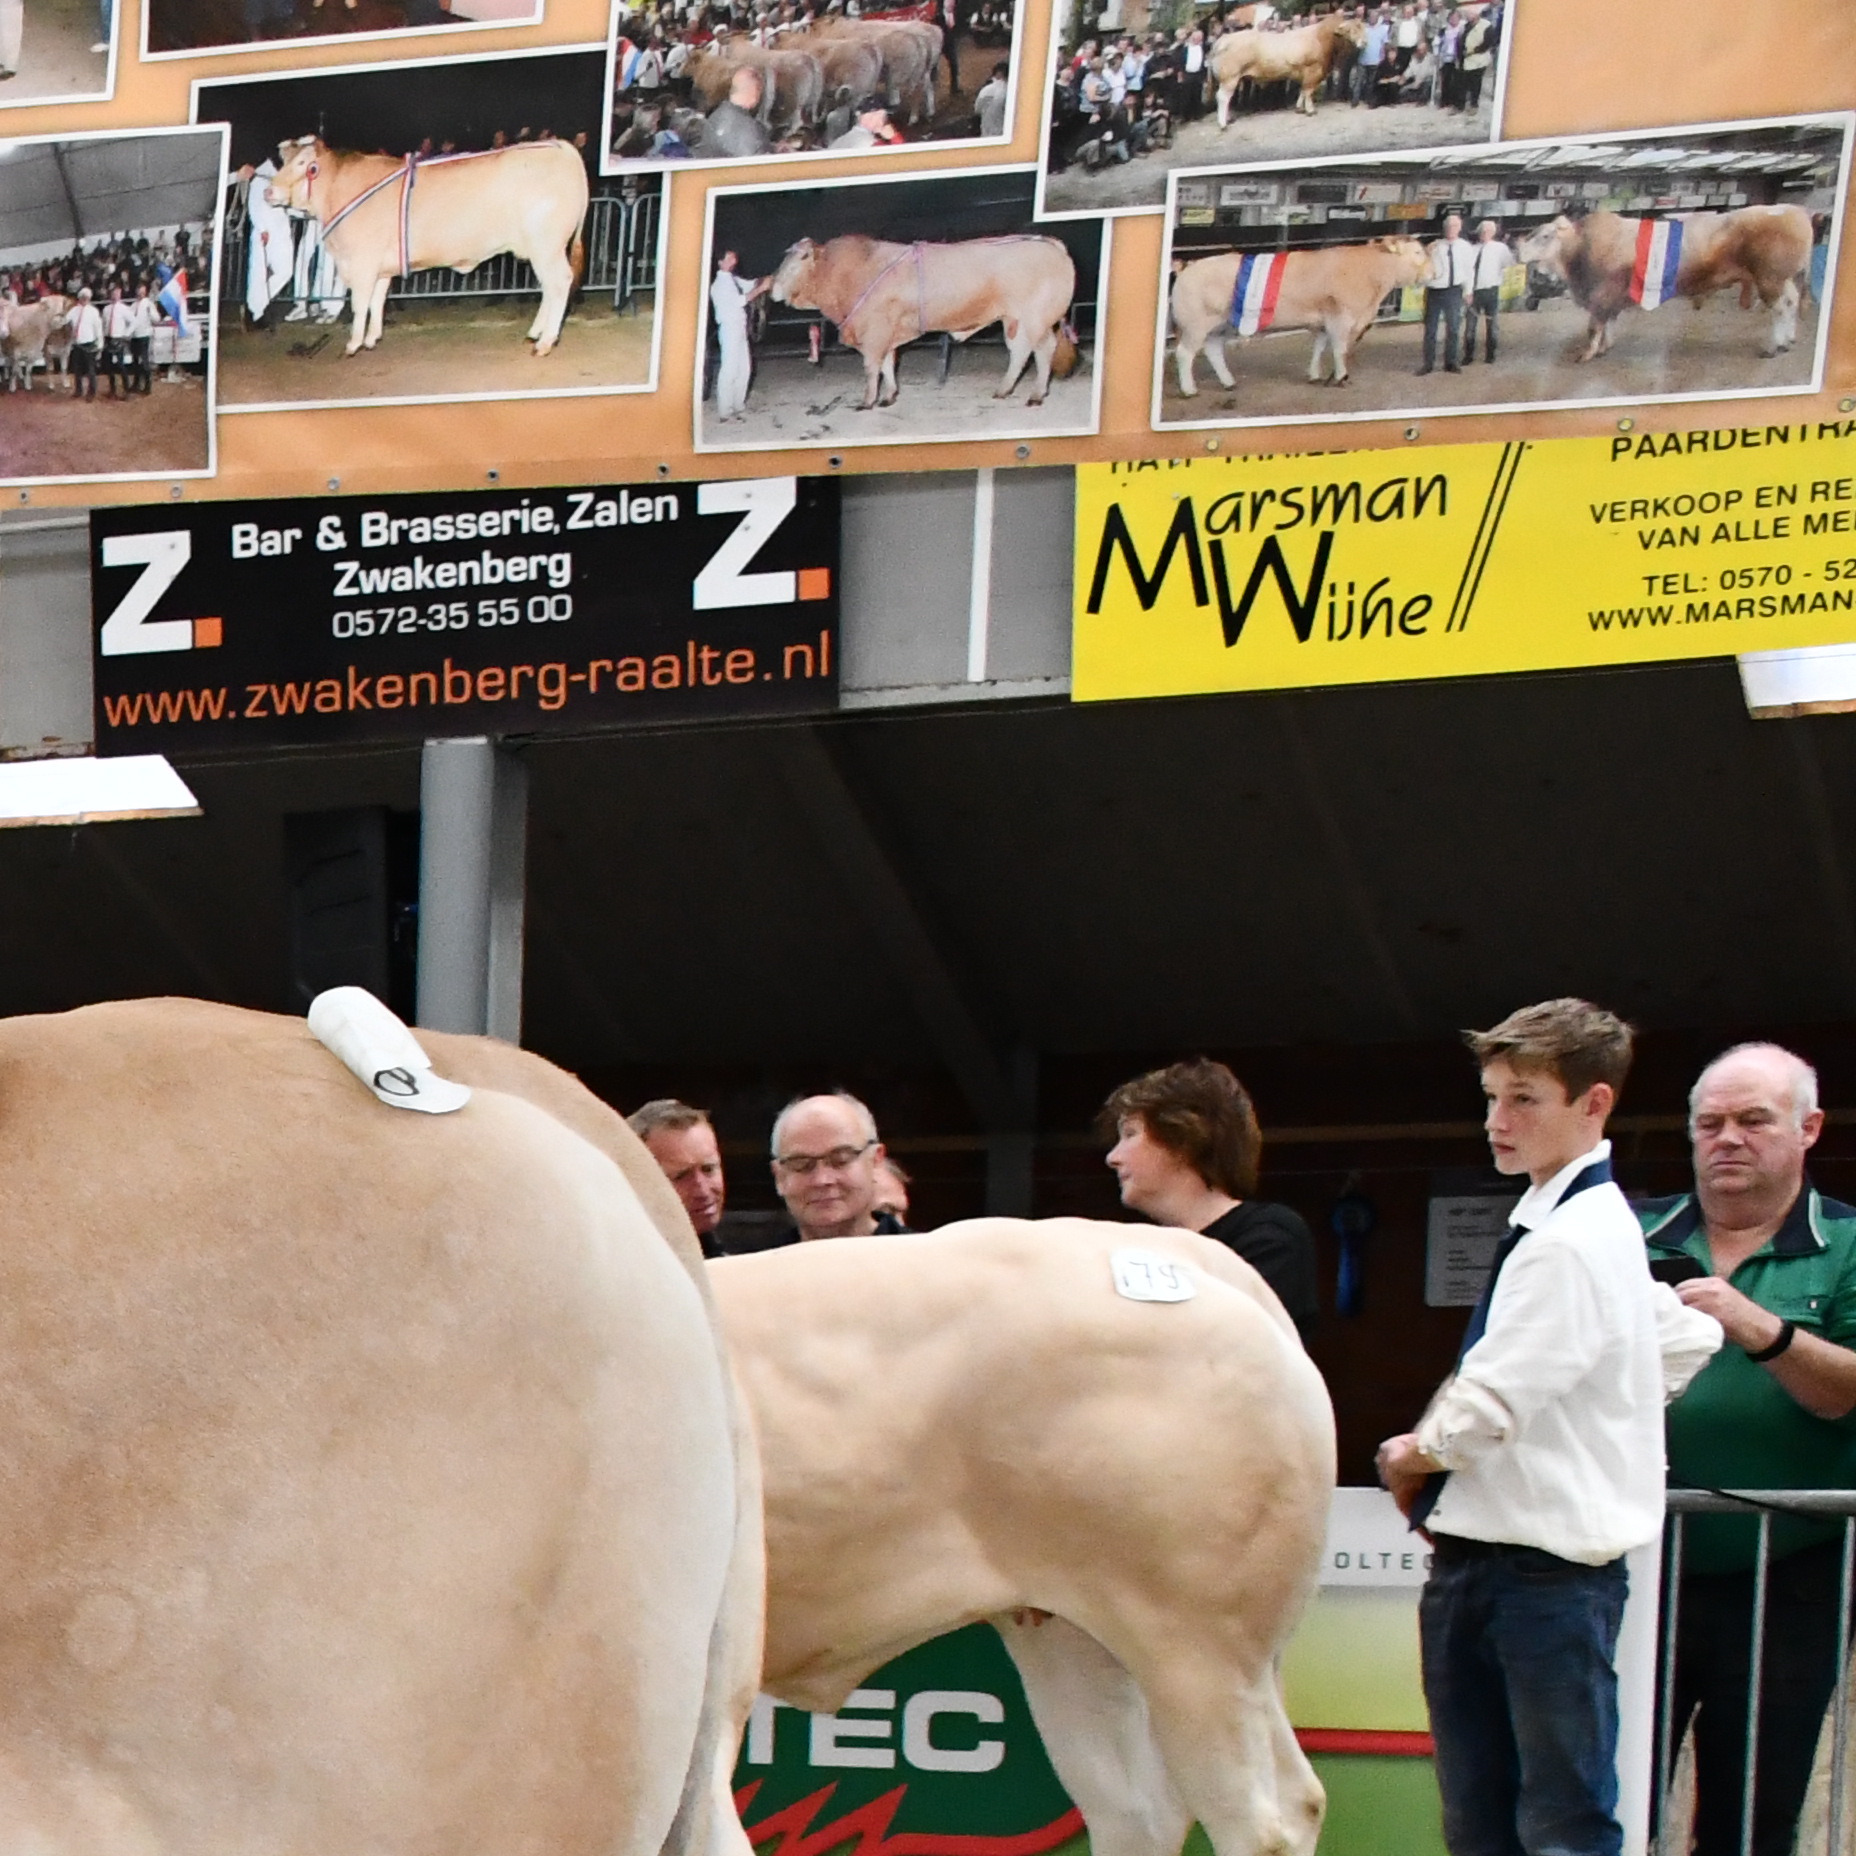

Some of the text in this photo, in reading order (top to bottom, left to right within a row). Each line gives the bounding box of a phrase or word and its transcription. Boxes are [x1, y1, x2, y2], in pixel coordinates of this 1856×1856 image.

[232, 491, 680, 559] Bar & Brasserie, Zalen
[1590, 490, 1743, 524] VERKOOP
[1755, 484, 1798, 509] EN
[1087, 474, 1448, 615] Marsman
[1638, 510, 1856, 550] VAN ALLE ME
[333, 548, 573, 597] Zwakenberg
[1642, 572, 1708, 597] TEL:
[1719, 564, 1792, 591] 0570
[331, 594, 573, 639] 0572-35 55 00
[103, 630, 831, 728] www.zwakenberg-raalte.nl
